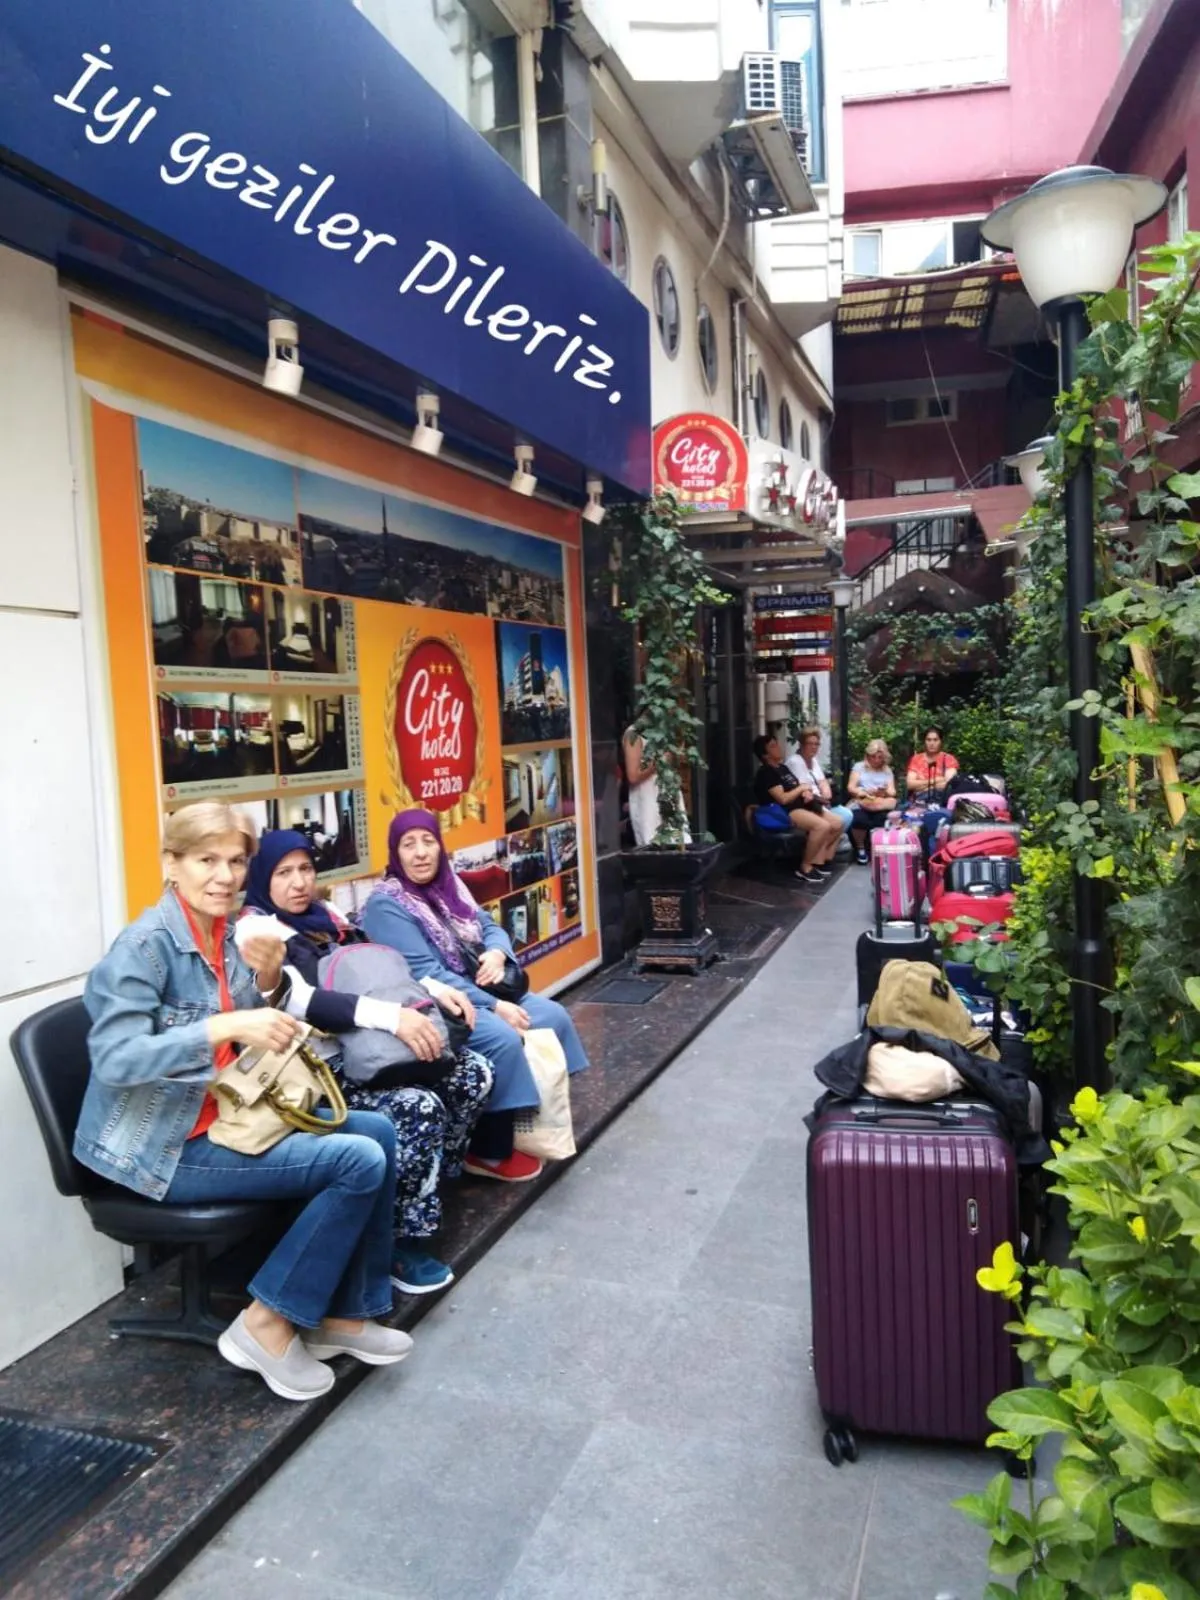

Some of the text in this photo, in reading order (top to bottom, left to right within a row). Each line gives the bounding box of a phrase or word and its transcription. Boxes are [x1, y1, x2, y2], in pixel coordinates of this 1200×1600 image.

[671, 437, 721, 464] City
[681, 460, 716, 474] hotel
[405, 668, 464, 735] City
[420, 727, 461, 761] hotel
